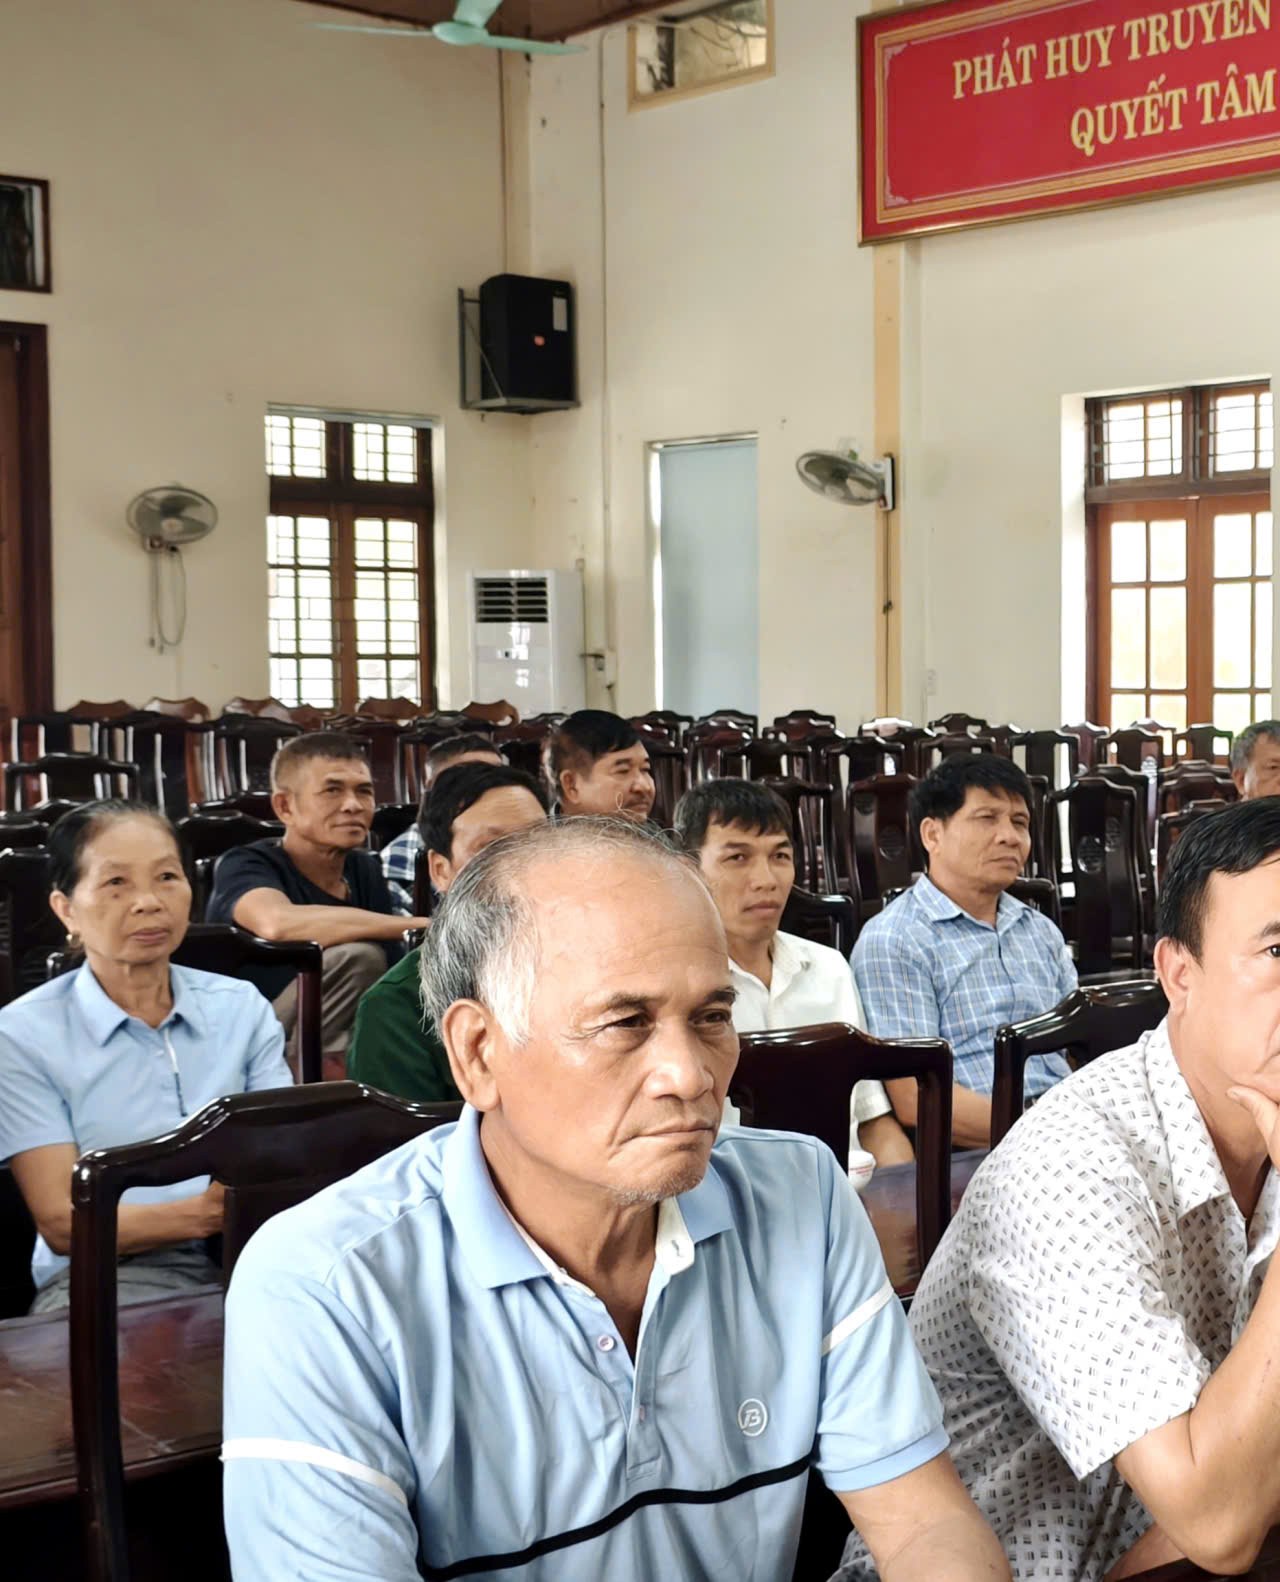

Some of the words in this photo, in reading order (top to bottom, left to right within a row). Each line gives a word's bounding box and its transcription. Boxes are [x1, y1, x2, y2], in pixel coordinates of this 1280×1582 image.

[953, 36, 1037, 99] PHÁT
[1045, 25, 1116, 80] HUY
[1070, 73, 1188, 157] QUYẾT
[1196, 62, 1277, 125] TÂM
